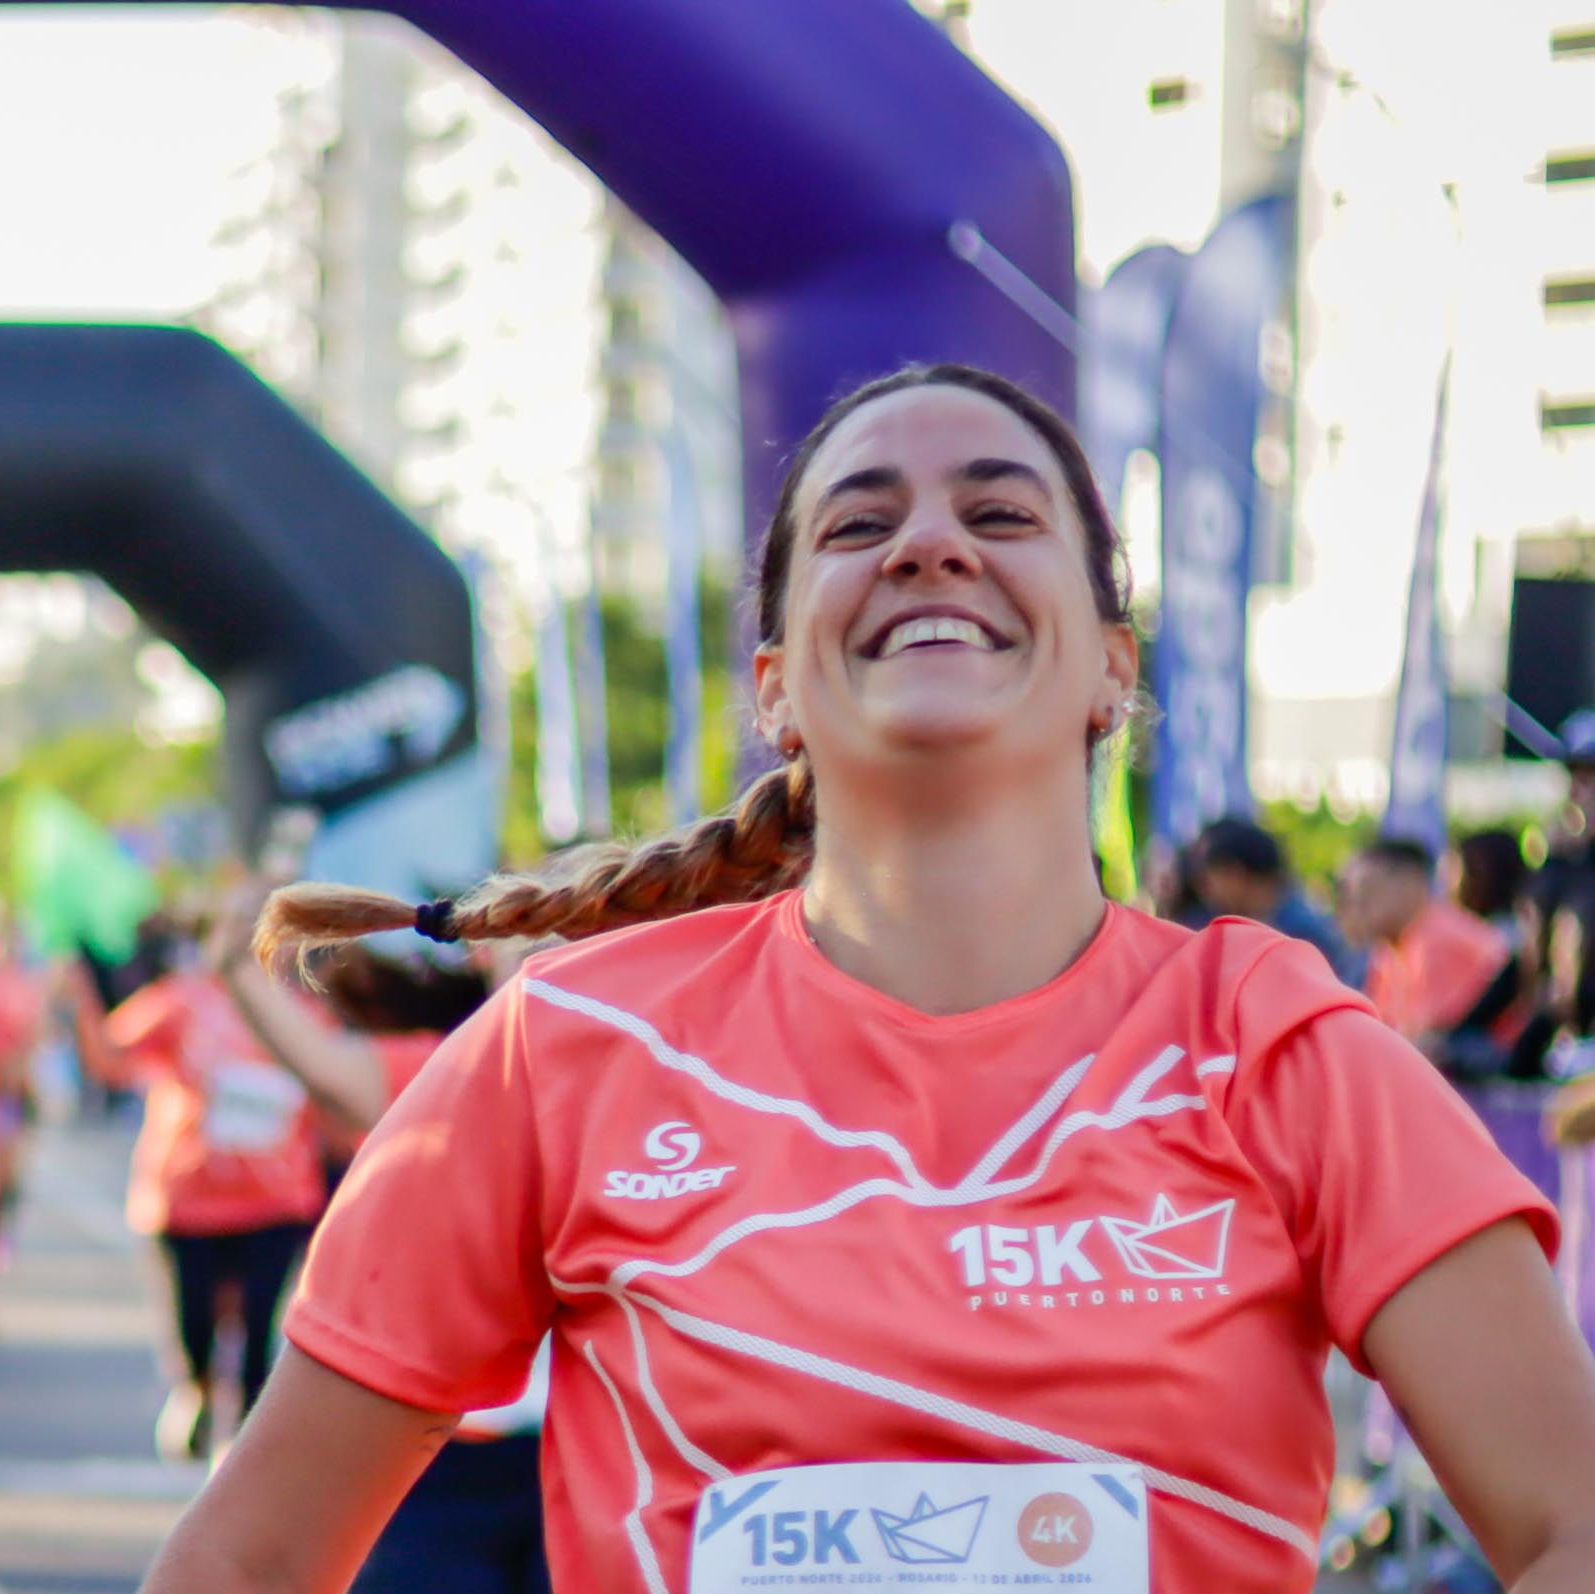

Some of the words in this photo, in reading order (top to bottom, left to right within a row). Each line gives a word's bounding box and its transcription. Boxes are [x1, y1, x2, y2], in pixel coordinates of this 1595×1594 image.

[949, 1219, 1104, 1287] 15K
[970, 1290, 1104, 1312] PUERTO
[1120, 1284, 1231, 1302] NORTE
[741, 1509, 861, 1567] 15K
[1030, 1516, 1079, 1545] 4K
[741, 1575, 795, 1586] PUERTO
[799, 1574, 843, 1585] NORTE
[897, 1572, 957, 1583] ROSARIO
[1014, 1573, 1053, 1584] ABRIL
